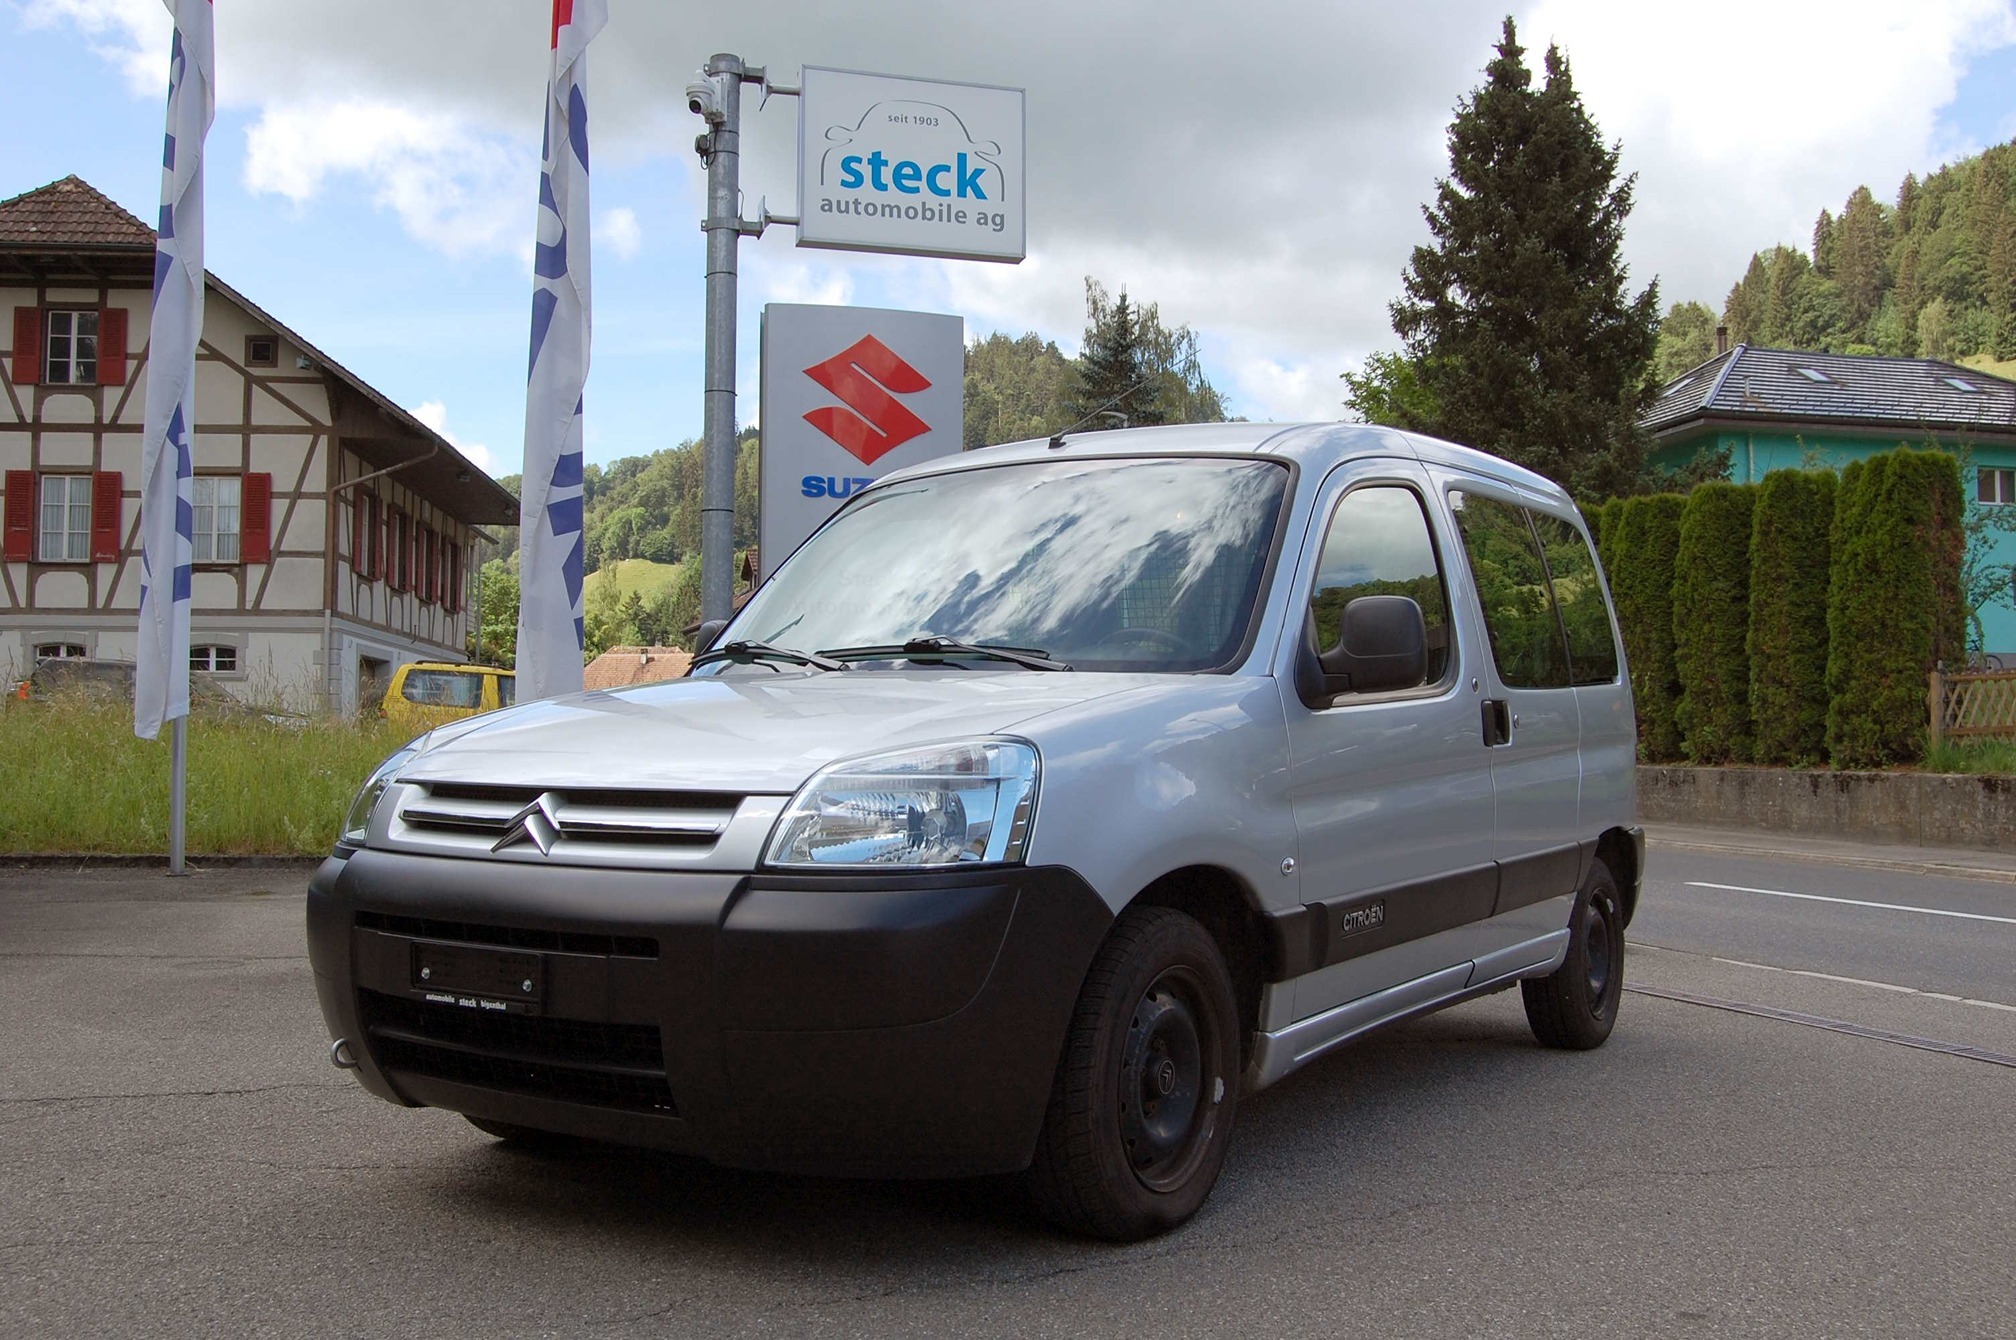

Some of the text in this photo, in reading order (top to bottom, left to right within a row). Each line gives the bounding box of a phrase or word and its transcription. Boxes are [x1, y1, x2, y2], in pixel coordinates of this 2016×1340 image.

[887, 113, 939, 127] seit 1903
[840, 151, 988, 200] steck
[820, 197, 1005, 232] automobile ag
[801, 475, 878, 499] SUZ
[426, 994, 455, 1003] automobile
[460, 998, 477, 1008] steck
